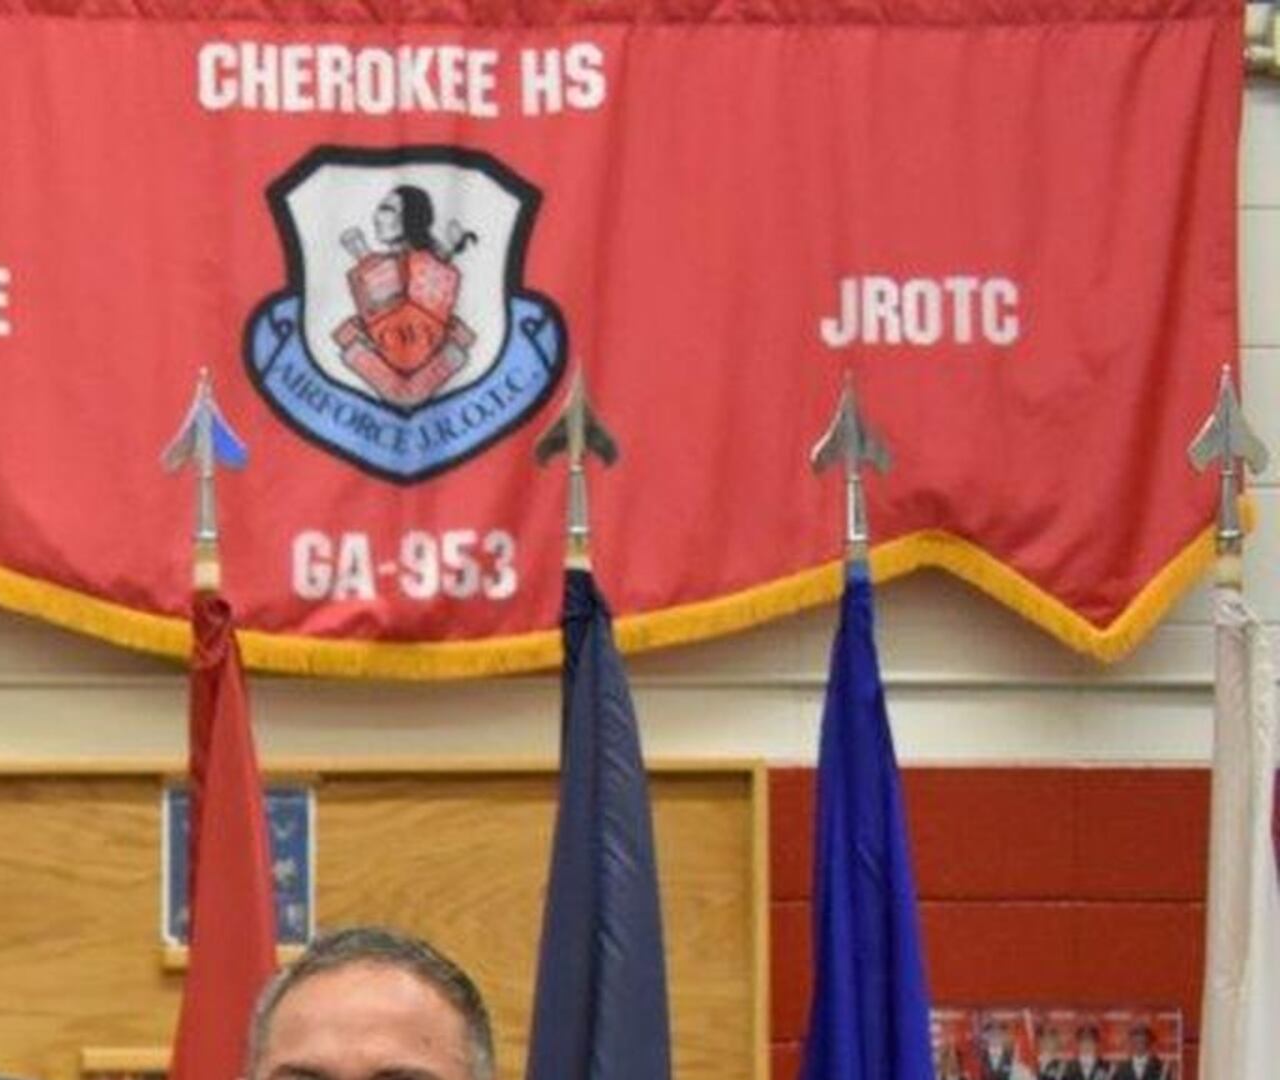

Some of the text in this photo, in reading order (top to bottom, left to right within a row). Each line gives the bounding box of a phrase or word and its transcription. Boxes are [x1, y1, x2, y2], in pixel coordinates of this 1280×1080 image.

[197, 42, 607, 117] CHEROKEE HS
[818, 273, 1020, 347] JROTC
[291, 529, 517, 601] GA-953
